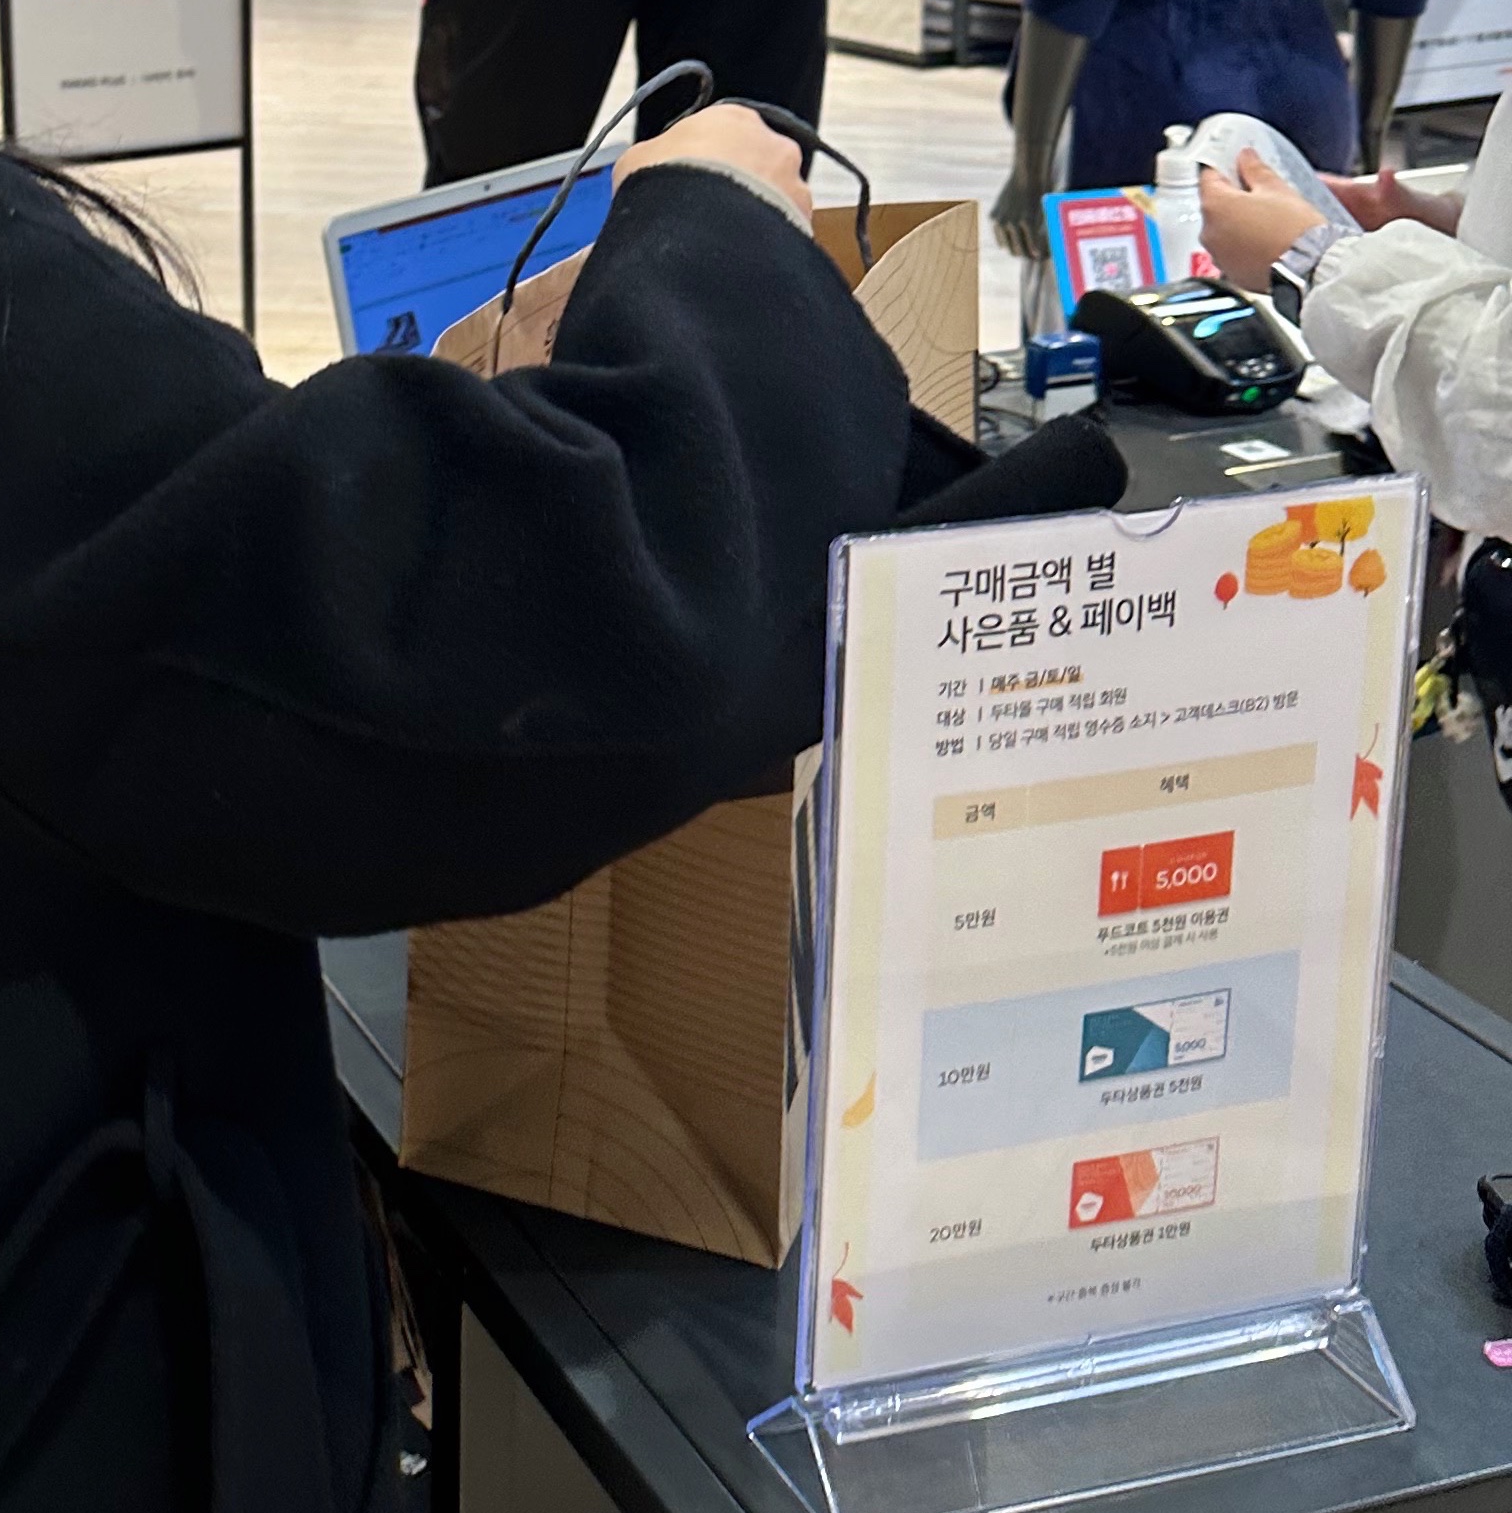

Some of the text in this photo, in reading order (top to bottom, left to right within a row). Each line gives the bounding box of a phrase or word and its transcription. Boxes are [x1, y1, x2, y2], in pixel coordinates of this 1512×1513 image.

[940, 551, 1116, 607] 구매금액 별
[938, 590, 1176, 654] 사은품 & 페이백
[939, 665, 1081, 698] 기간 매주 금/토/일
[937, 707, 965, 726] 대상
[1036, 695, 1063, 715] 구매
[1100, 687, 1127, 705] 회원
[935, 737, 964, 756] 방법
[989, 730, 1017, 750] 당일
[1021, 726, 1048, 745] 구매
[1085, 715, 1124, 737] 영수증
[1130, 711, 1156, 729] 소지
[1273, 690, 1299, 710] 방문
[965, 802, 996, 823] 금액
[1155, 862, 1218, 890] 5,000
[953, 907, 997, 931] 5만원
[1151, 914, 1187, 933] 5천원
[1191, 907, 1229, 925] 이용권
[938, 1062, 991, 1088] 10만원
[930, 1218, 982, 1243] 20만원
